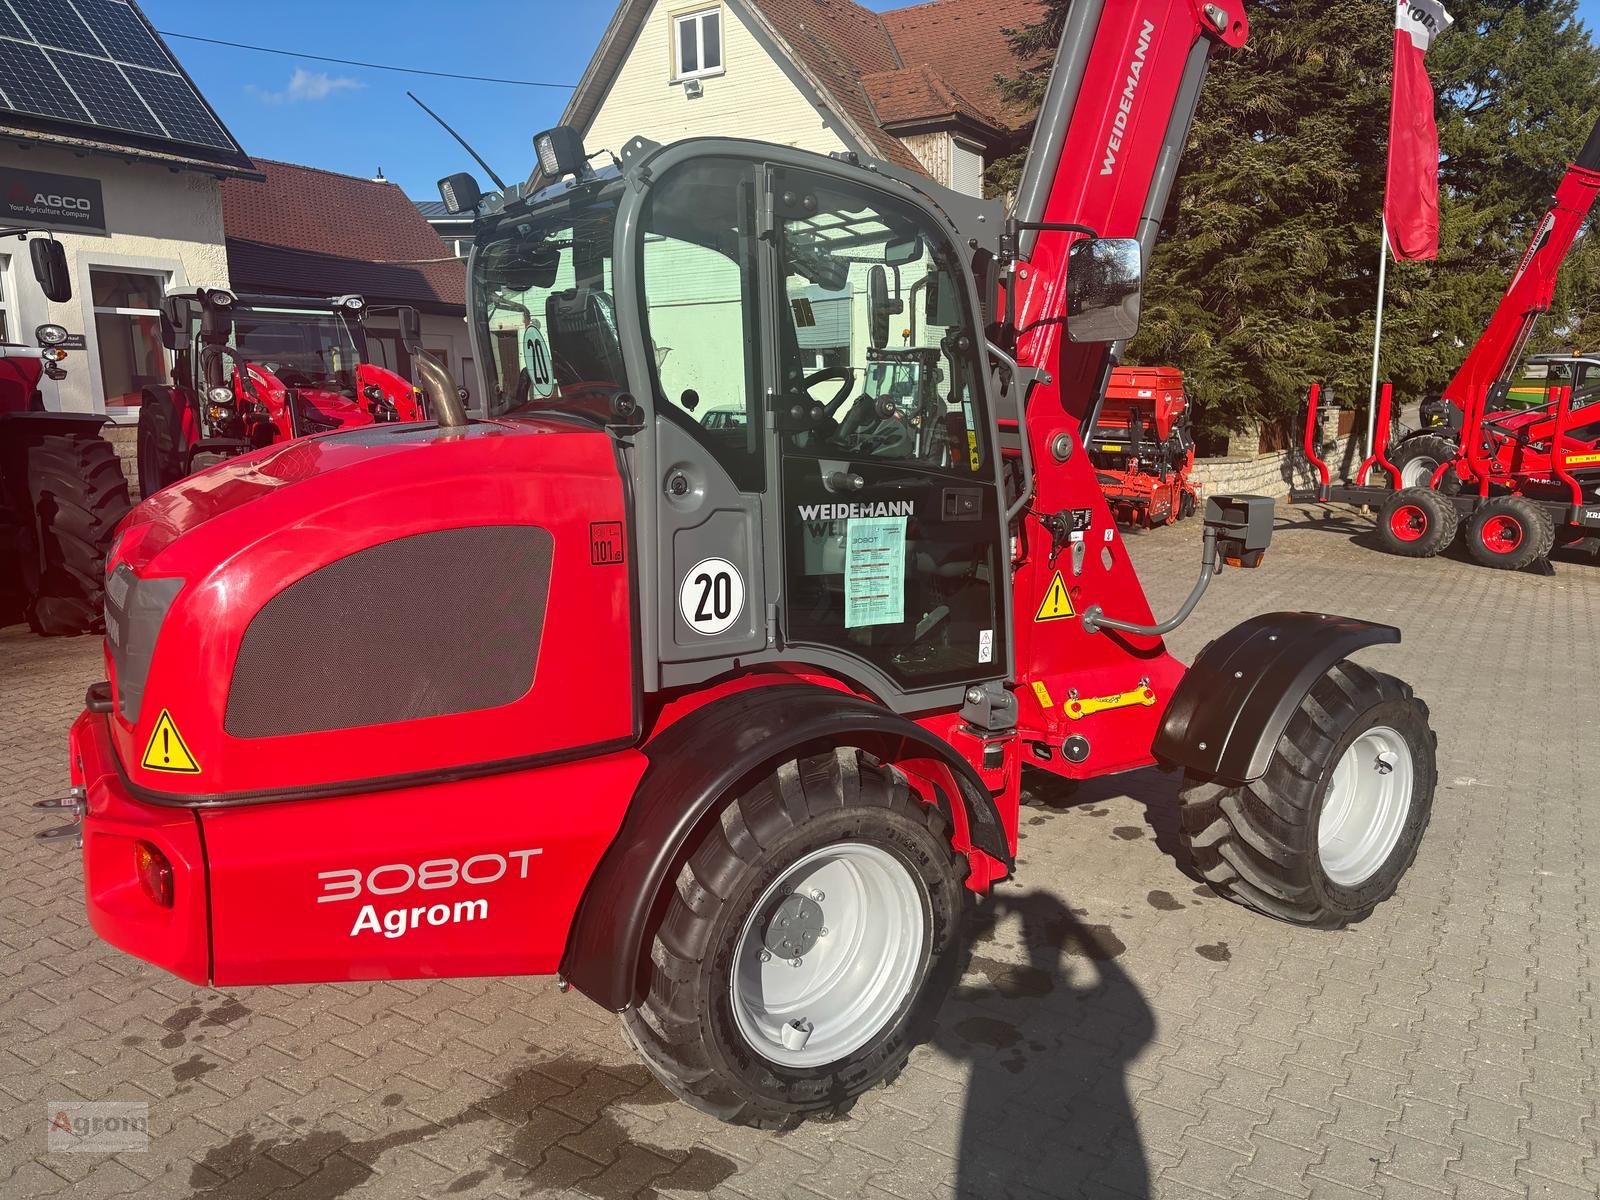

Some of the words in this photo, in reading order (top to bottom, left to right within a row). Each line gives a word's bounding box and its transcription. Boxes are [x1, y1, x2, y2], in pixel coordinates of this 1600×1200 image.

[1100, 19, 1155, 175] WEIDEMANN
[9, 203, 24, 211] Your
[25, 205, 60, 215] Agriculture
[61, 209, 90, 220] Company
[33, 193, 91, 210] AGCO
[1520, 247, 1535, 271] MASSEY
[1533, 213, 1552, 246] FERGUSON
[527, 338, 549, 385] 20
[798, 500, 914, 520] WEIDEMANN
[593, 540, 613, 561] 101
[695, 571, 732, 622] 20
[317, 848, 543, 903] 3080T
[350, 899, 488, 939] Agrom
